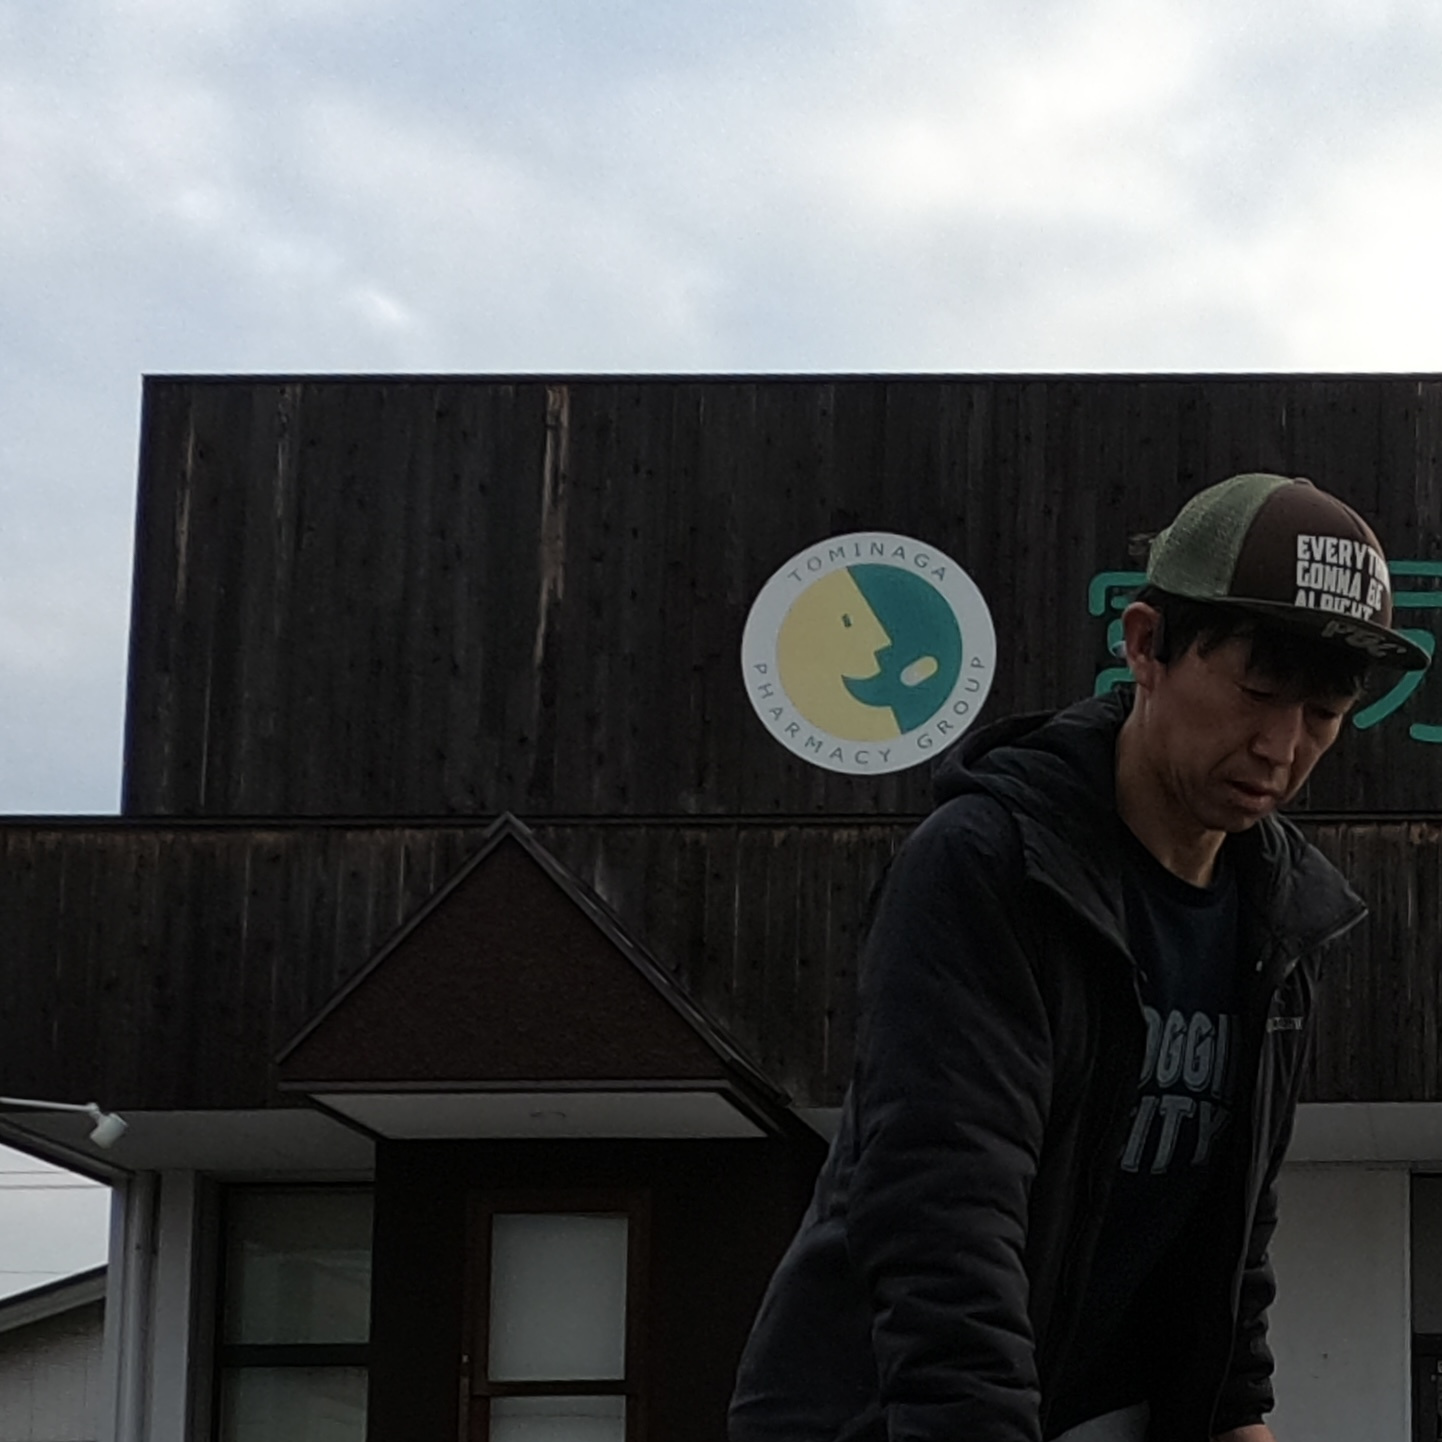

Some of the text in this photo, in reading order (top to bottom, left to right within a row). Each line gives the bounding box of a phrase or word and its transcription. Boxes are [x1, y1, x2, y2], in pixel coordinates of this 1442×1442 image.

[787, 542, 947, 582] TOMINAGA
[1296, 560, 1362, 602] GONNA
[753, 656, 986, 764] PHARMACY GROUP
